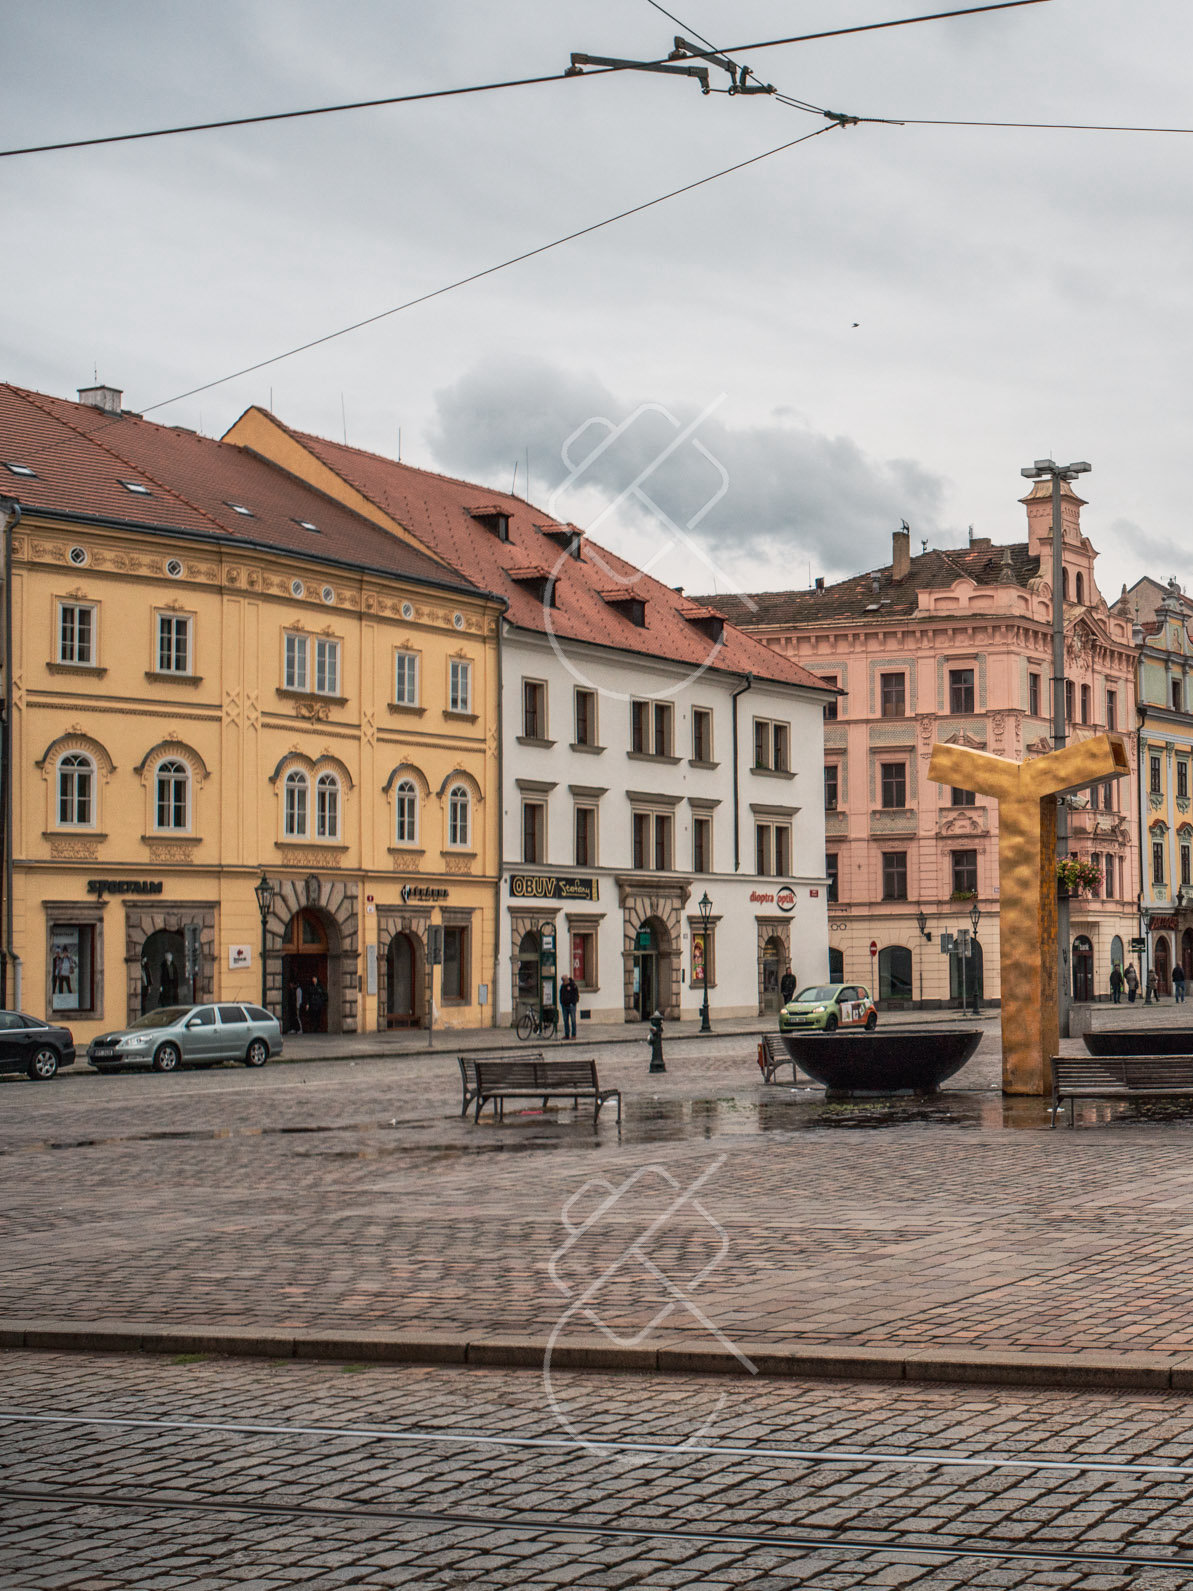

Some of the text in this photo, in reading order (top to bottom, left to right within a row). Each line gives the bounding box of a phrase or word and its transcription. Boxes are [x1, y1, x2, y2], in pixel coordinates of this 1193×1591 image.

[513, 876, 555, 897] OBUV
[750, 891, 774, 905] dioptra
[777, 892, 795, 906] optik
